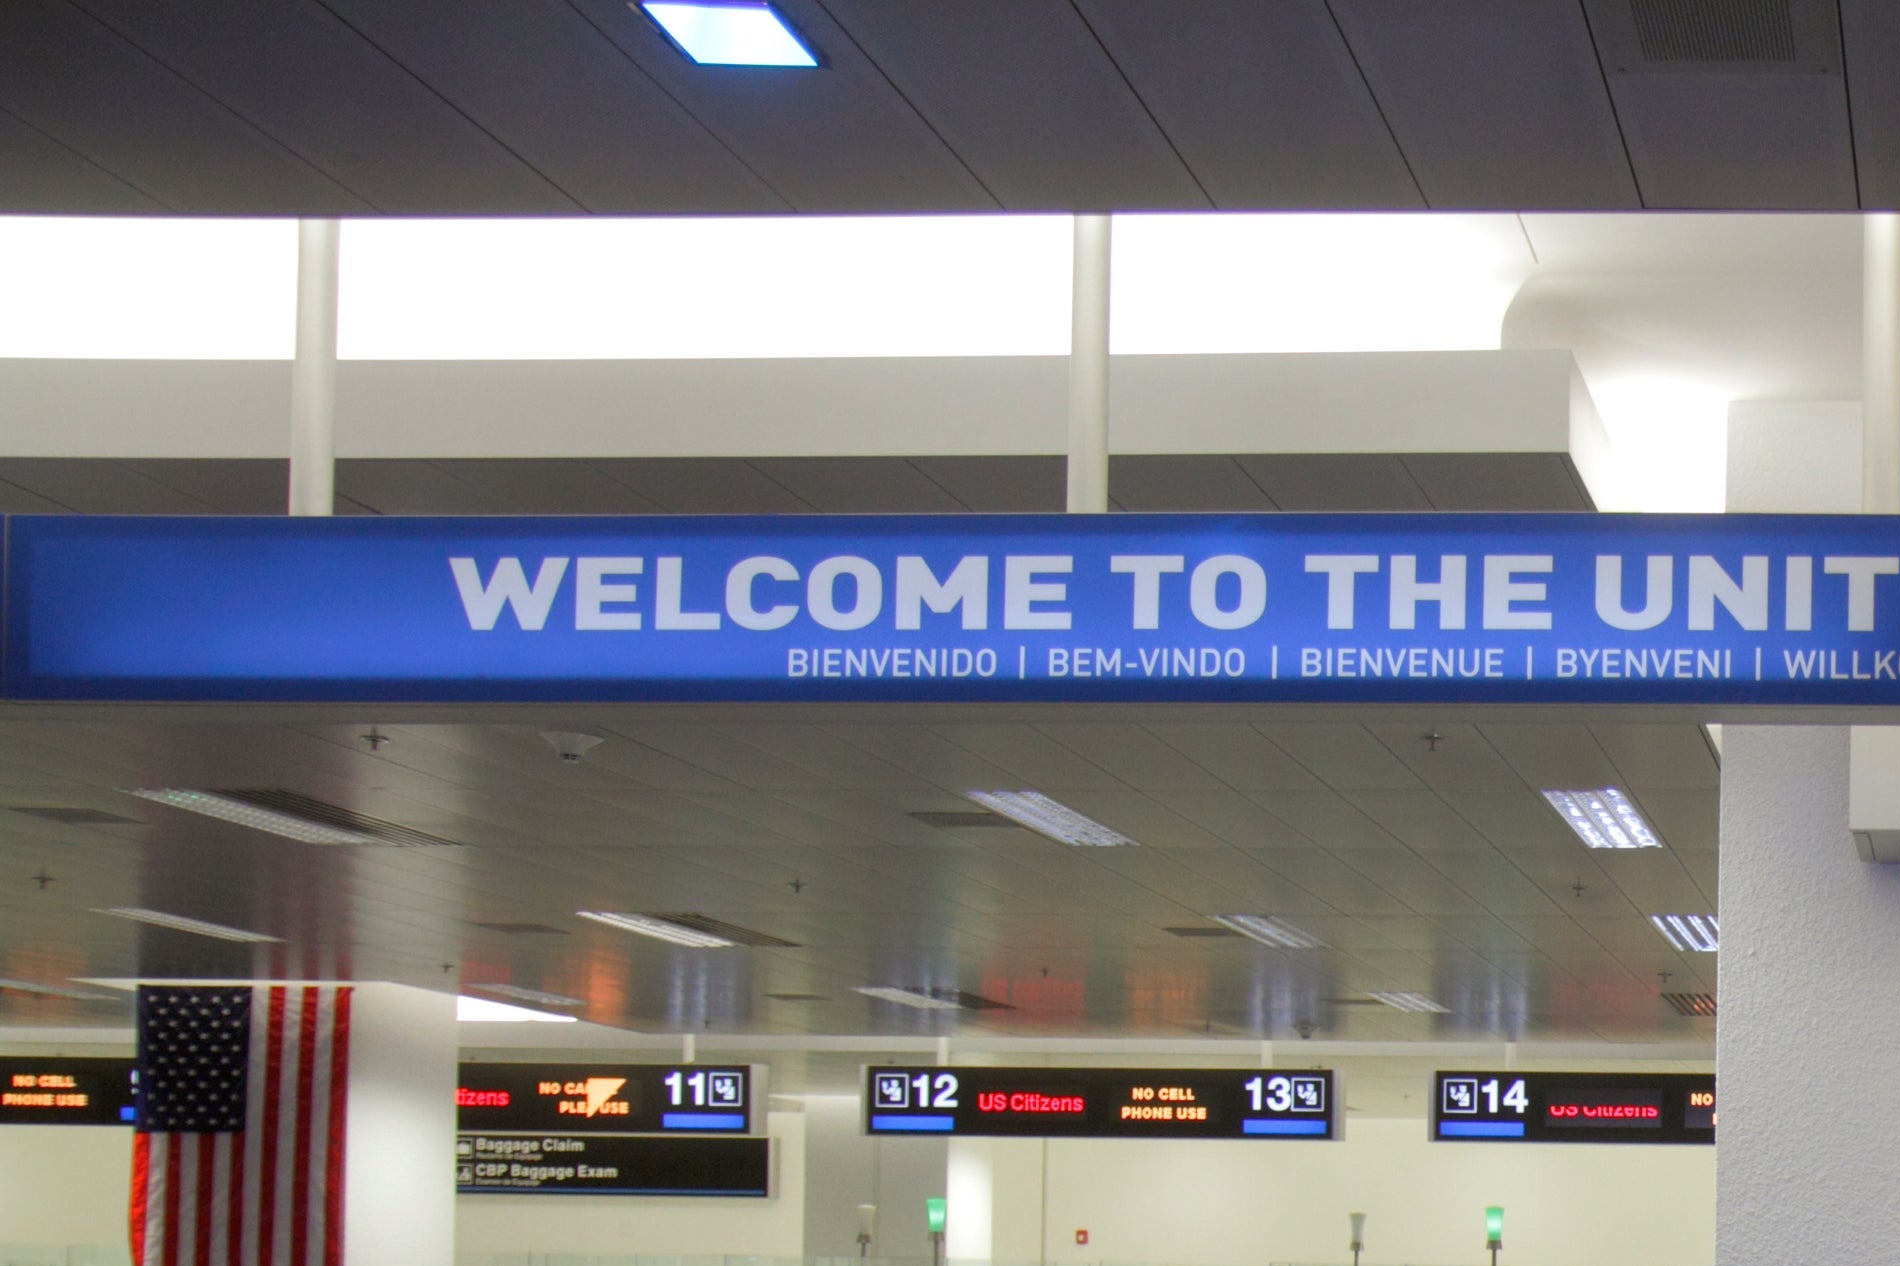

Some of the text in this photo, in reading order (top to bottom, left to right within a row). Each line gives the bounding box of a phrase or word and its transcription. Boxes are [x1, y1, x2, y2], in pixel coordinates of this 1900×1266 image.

[449, 554, 1073, 631] WELCOME
[1110, 554, 1267, 631] TO
[1304, 554, 1554, 631] THE
[787, 647, 997, 678] BIENVENIDO
[1047, 647, 1246, 678] BEM-VINDO
[1300, 648, 1504, 678] BIENVENUE
[1556, 648, 1731, 679] BYENVENI
[11, 1074, 37, 1087] NO
[539, 1082, 562, 1095] NO
[664, 1072, 705, 1106] 11
[55, 1094, 88, 1107] USE
[454, 1088, 510, 1106] tizens
[912, 1074, 958, 1108] 12
[1131, 1087, 1195, 1101] NO CELL
[1245, 1076, 1291, 1112] 13
[1481, 1079, 1529, 1114] 14
[1690, 1093, 1714, 1106] NO
[978, 1093, 1084, 1112] US Citizens
[1121, 1105, 1207, 1120] PHONE USE
[475, 1138, 585, 1153] Baggage Claim
[475, 1164, 619, 1180] CBP Baggage Exam
